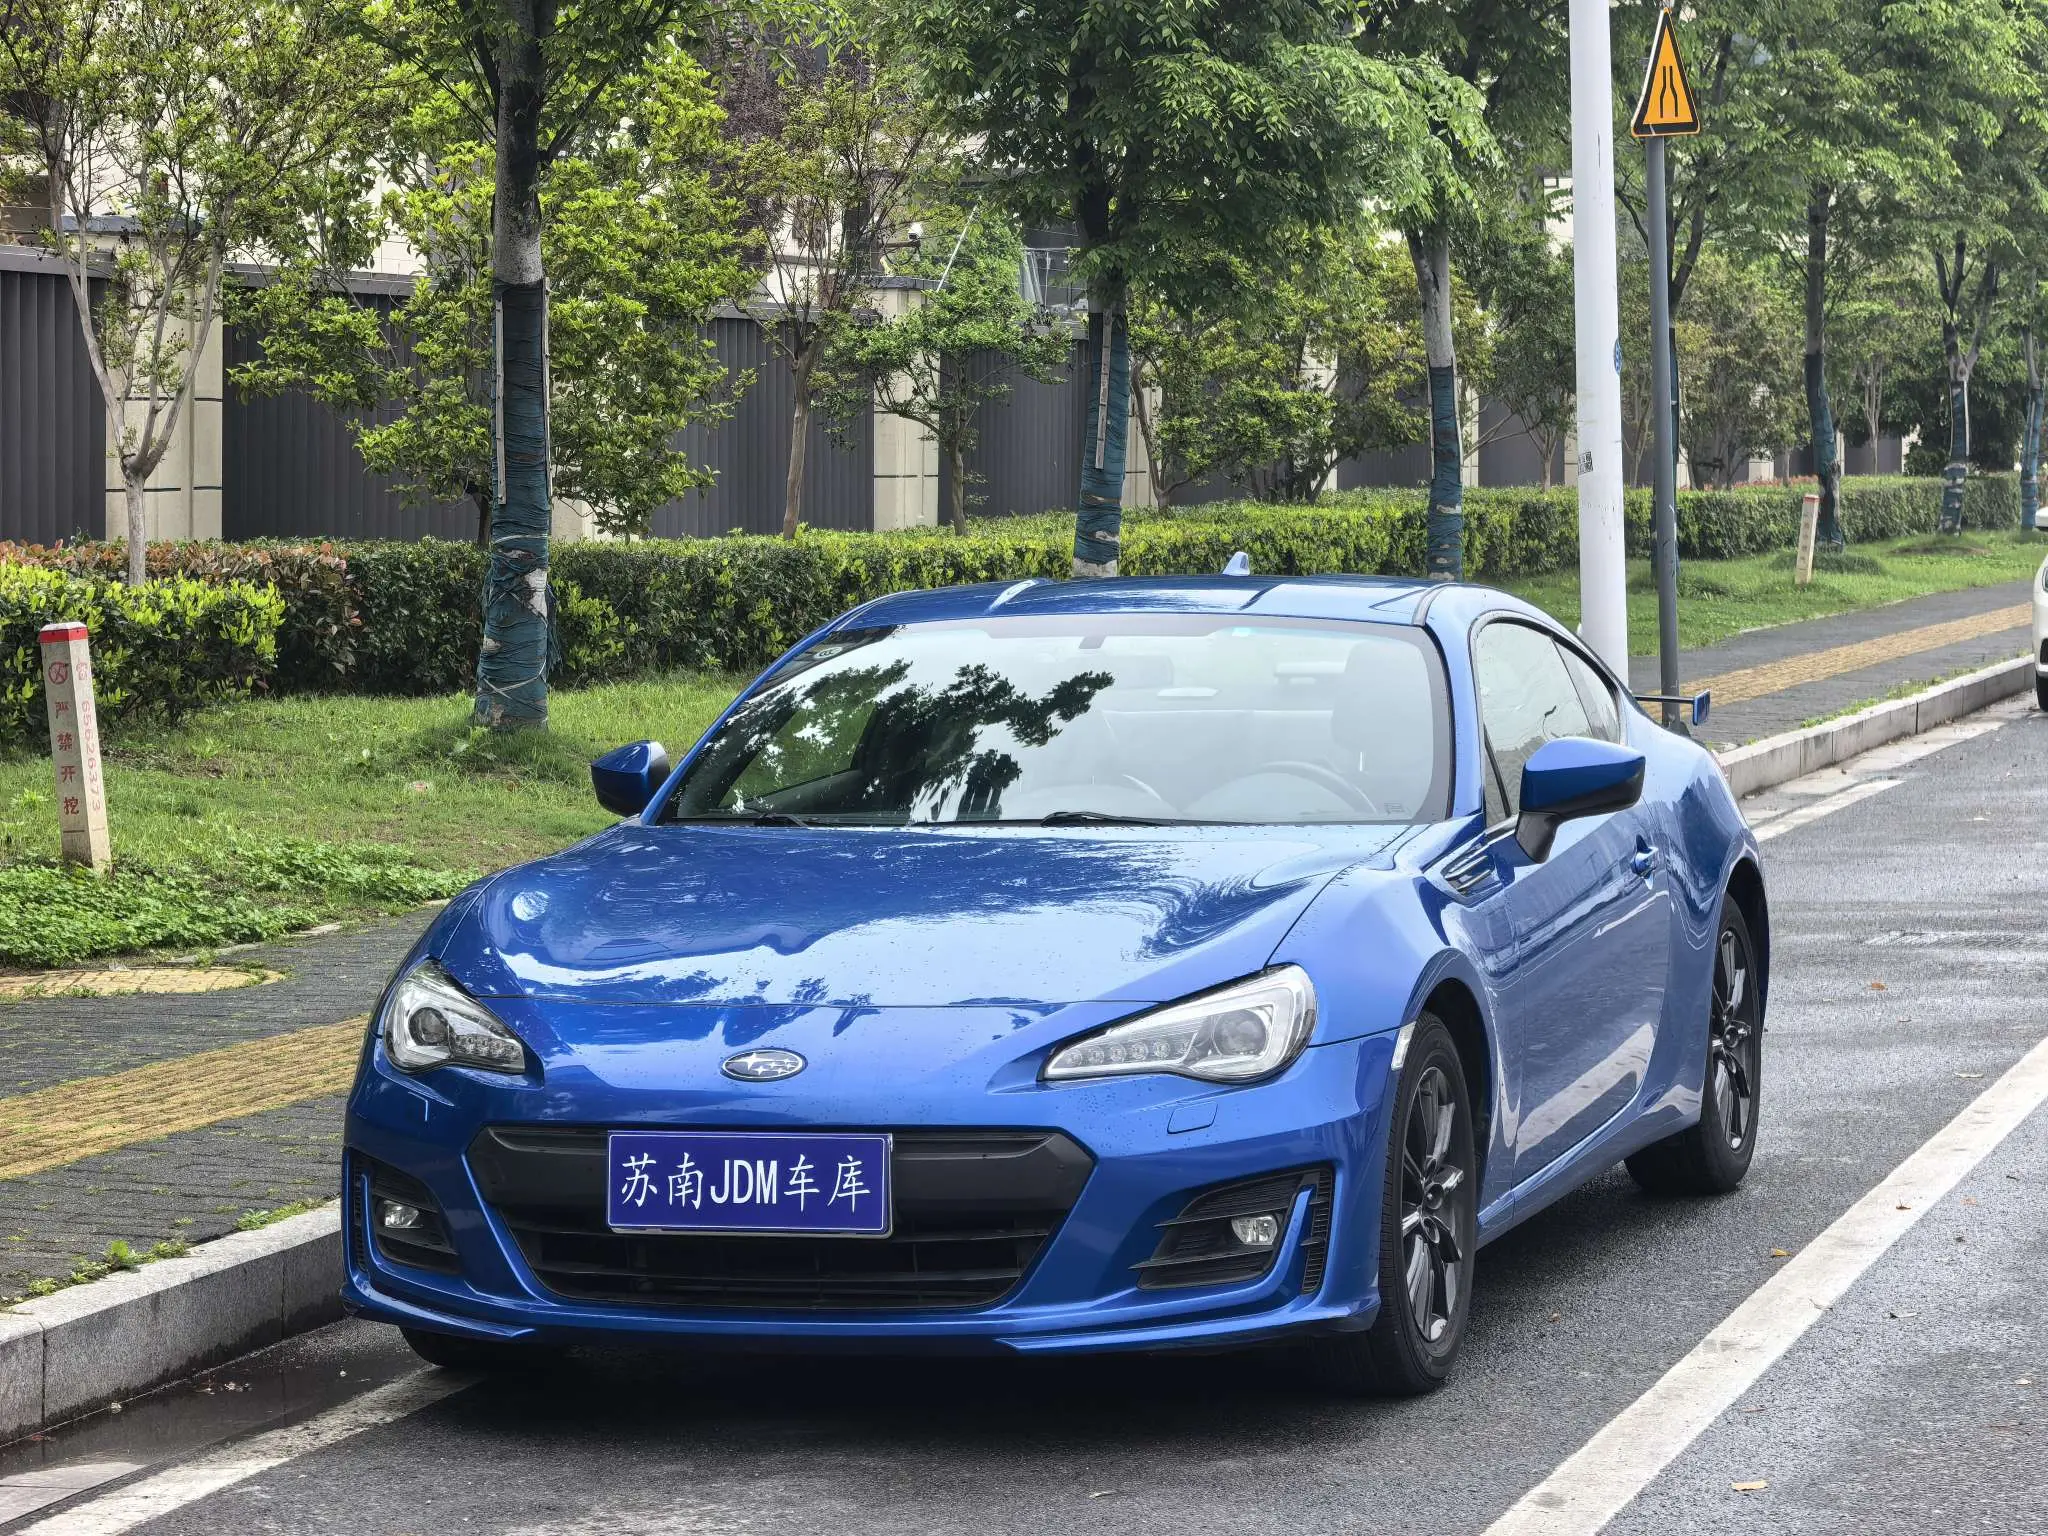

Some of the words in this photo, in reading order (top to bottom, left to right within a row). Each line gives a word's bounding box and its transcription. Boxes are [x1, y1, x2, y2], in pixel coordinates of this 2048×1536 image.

[55, 701, 79, 815] 严禁开挖
[82, 700, 101, 812] 65626373
[621, 1152, 870, 1213] 苏南JDM车库
